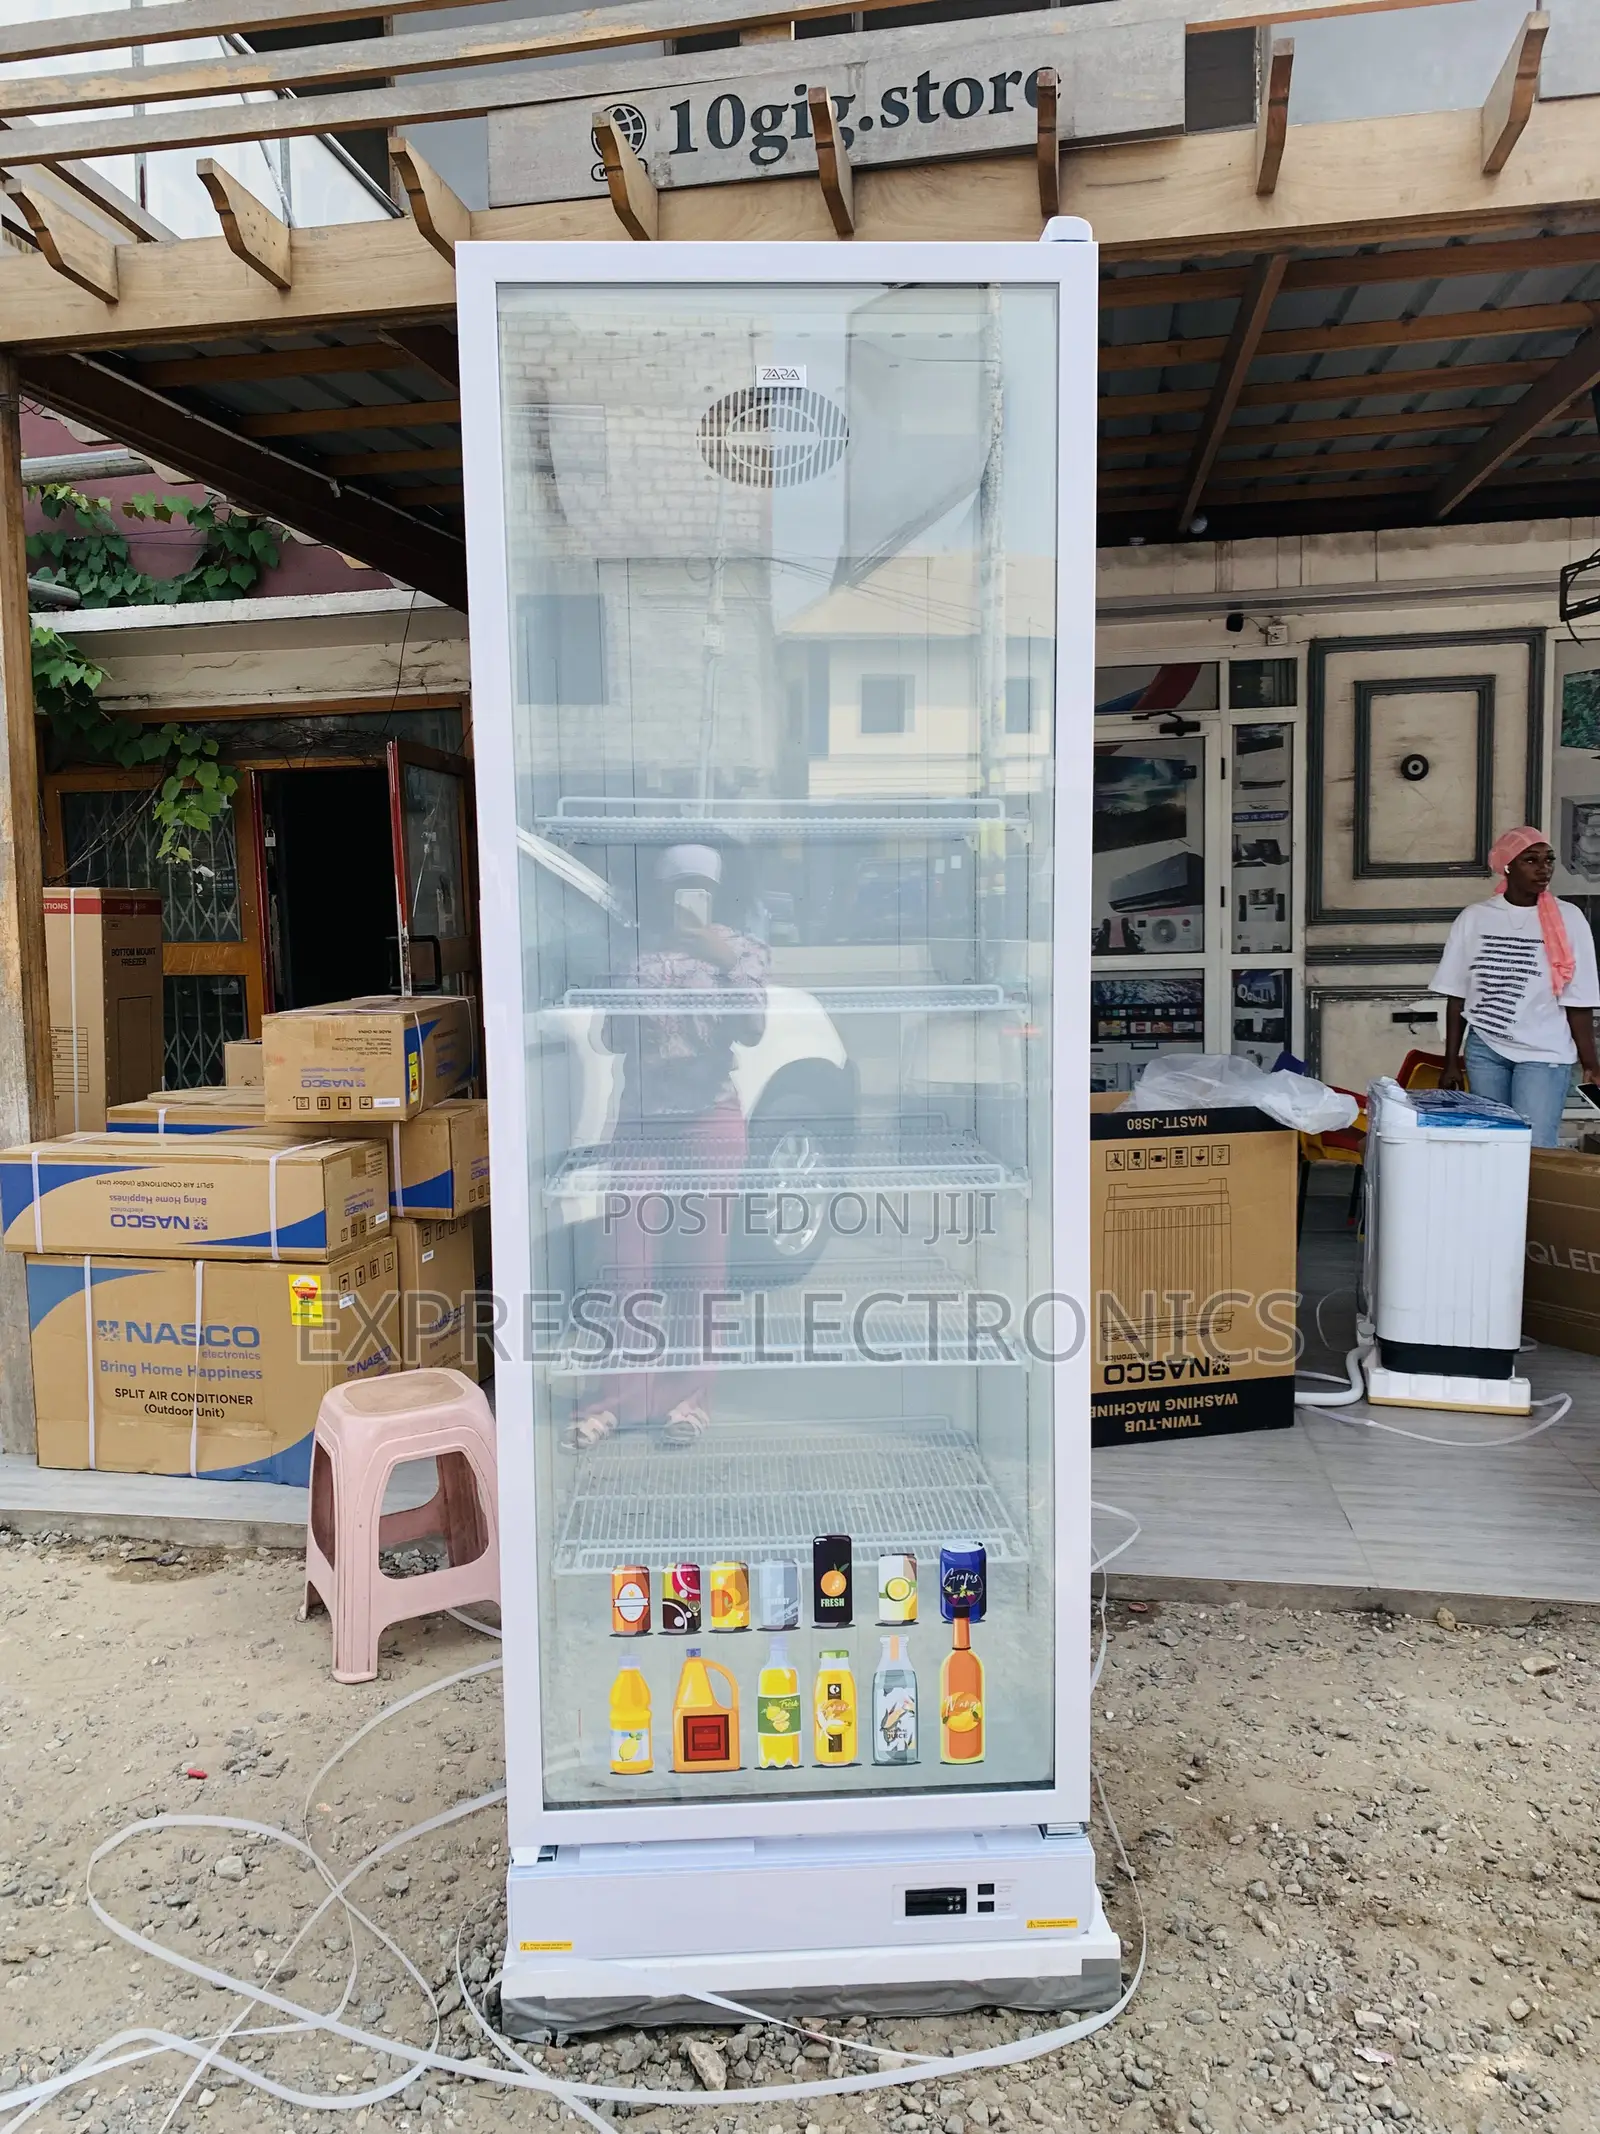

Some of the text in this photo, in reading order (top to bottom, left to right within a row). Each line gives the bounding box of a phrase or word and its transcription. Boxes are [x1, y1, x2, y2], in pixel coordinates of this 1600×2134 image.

[761, 368, 800, 380] ZARA
[111, 947, 156, 957] BOTTOM MOUNT
[121, 957, 147, 967] FREEZER
[301, 1079, 355, 1088] NASCO
[1126, 1115, 1208, 1131] NASTT-JS80
[96, 1178, 112, 1186] Unit)
[113, 1179, 136, 1187] (Indoor
[136, 1180, 182, 1188] CONDITIONER
[109, 1193, 207, 1206] Bring Home Happiness
[110, 1206, 144, 1214] electronics
[110, 1214, 190, 1230] NASCO
[125, 1321, 261, 1348] NASCO
[201, 1349, 261, 1360] electronics
[1104, 1352, 1150, 1362] electronics
[99, 1359, 263, 1381] Bring Home Happiness
[1103, 1356, 1211, 1386] NASCO
[114, 1387, 254, 1406] SPLIT AIR CONDITIONER
[144, 1403, 225, 1419] (Outdoor Unit)
[1090, 1392, 1239, 1419] WASHING MACHINE
[1124, 1414, 1203, 1433] TWIN-TUB
[820, 1597, 846, 1608] FRESH
